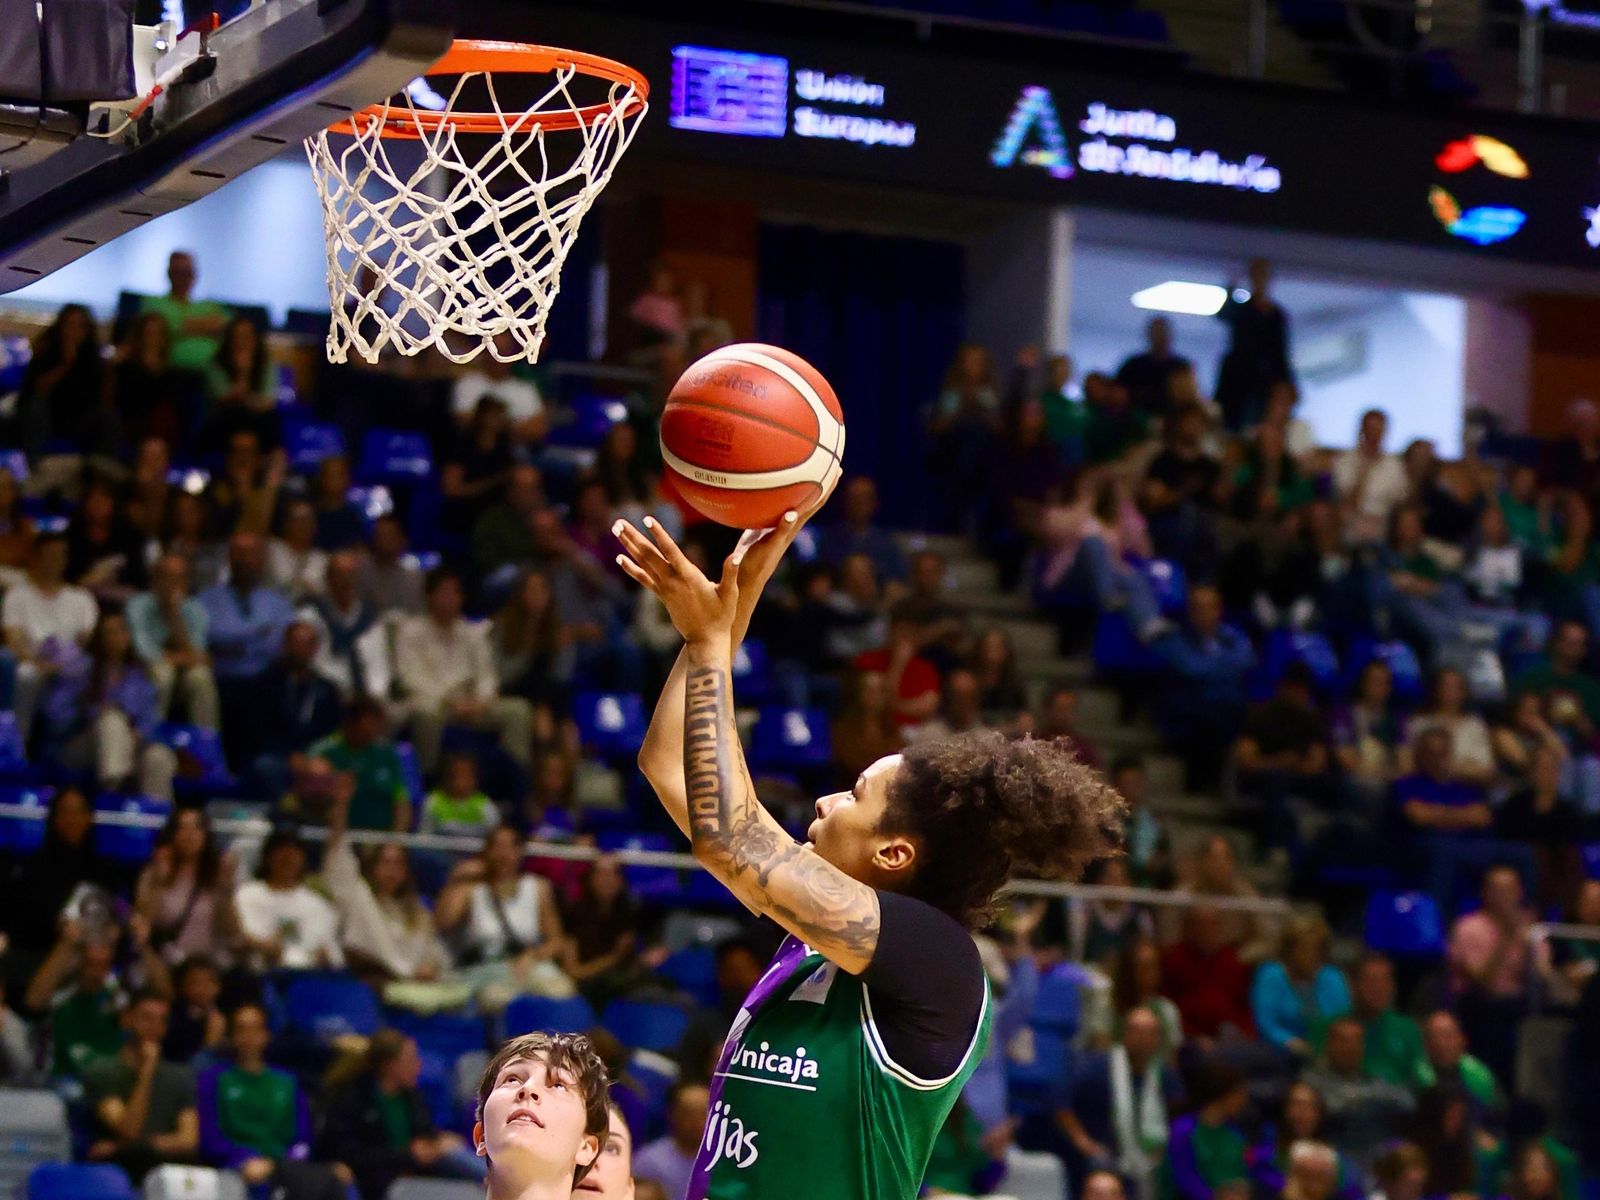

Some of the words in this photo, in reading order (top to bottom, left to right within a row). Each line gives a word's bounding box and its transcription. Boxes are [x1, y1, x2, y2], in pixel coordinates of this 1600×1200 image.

[1079, 101, 1176, 141] Junta
[730, 1040, 819, 1083] Unicaja
[704, 1100, 759, 1172] ijas
